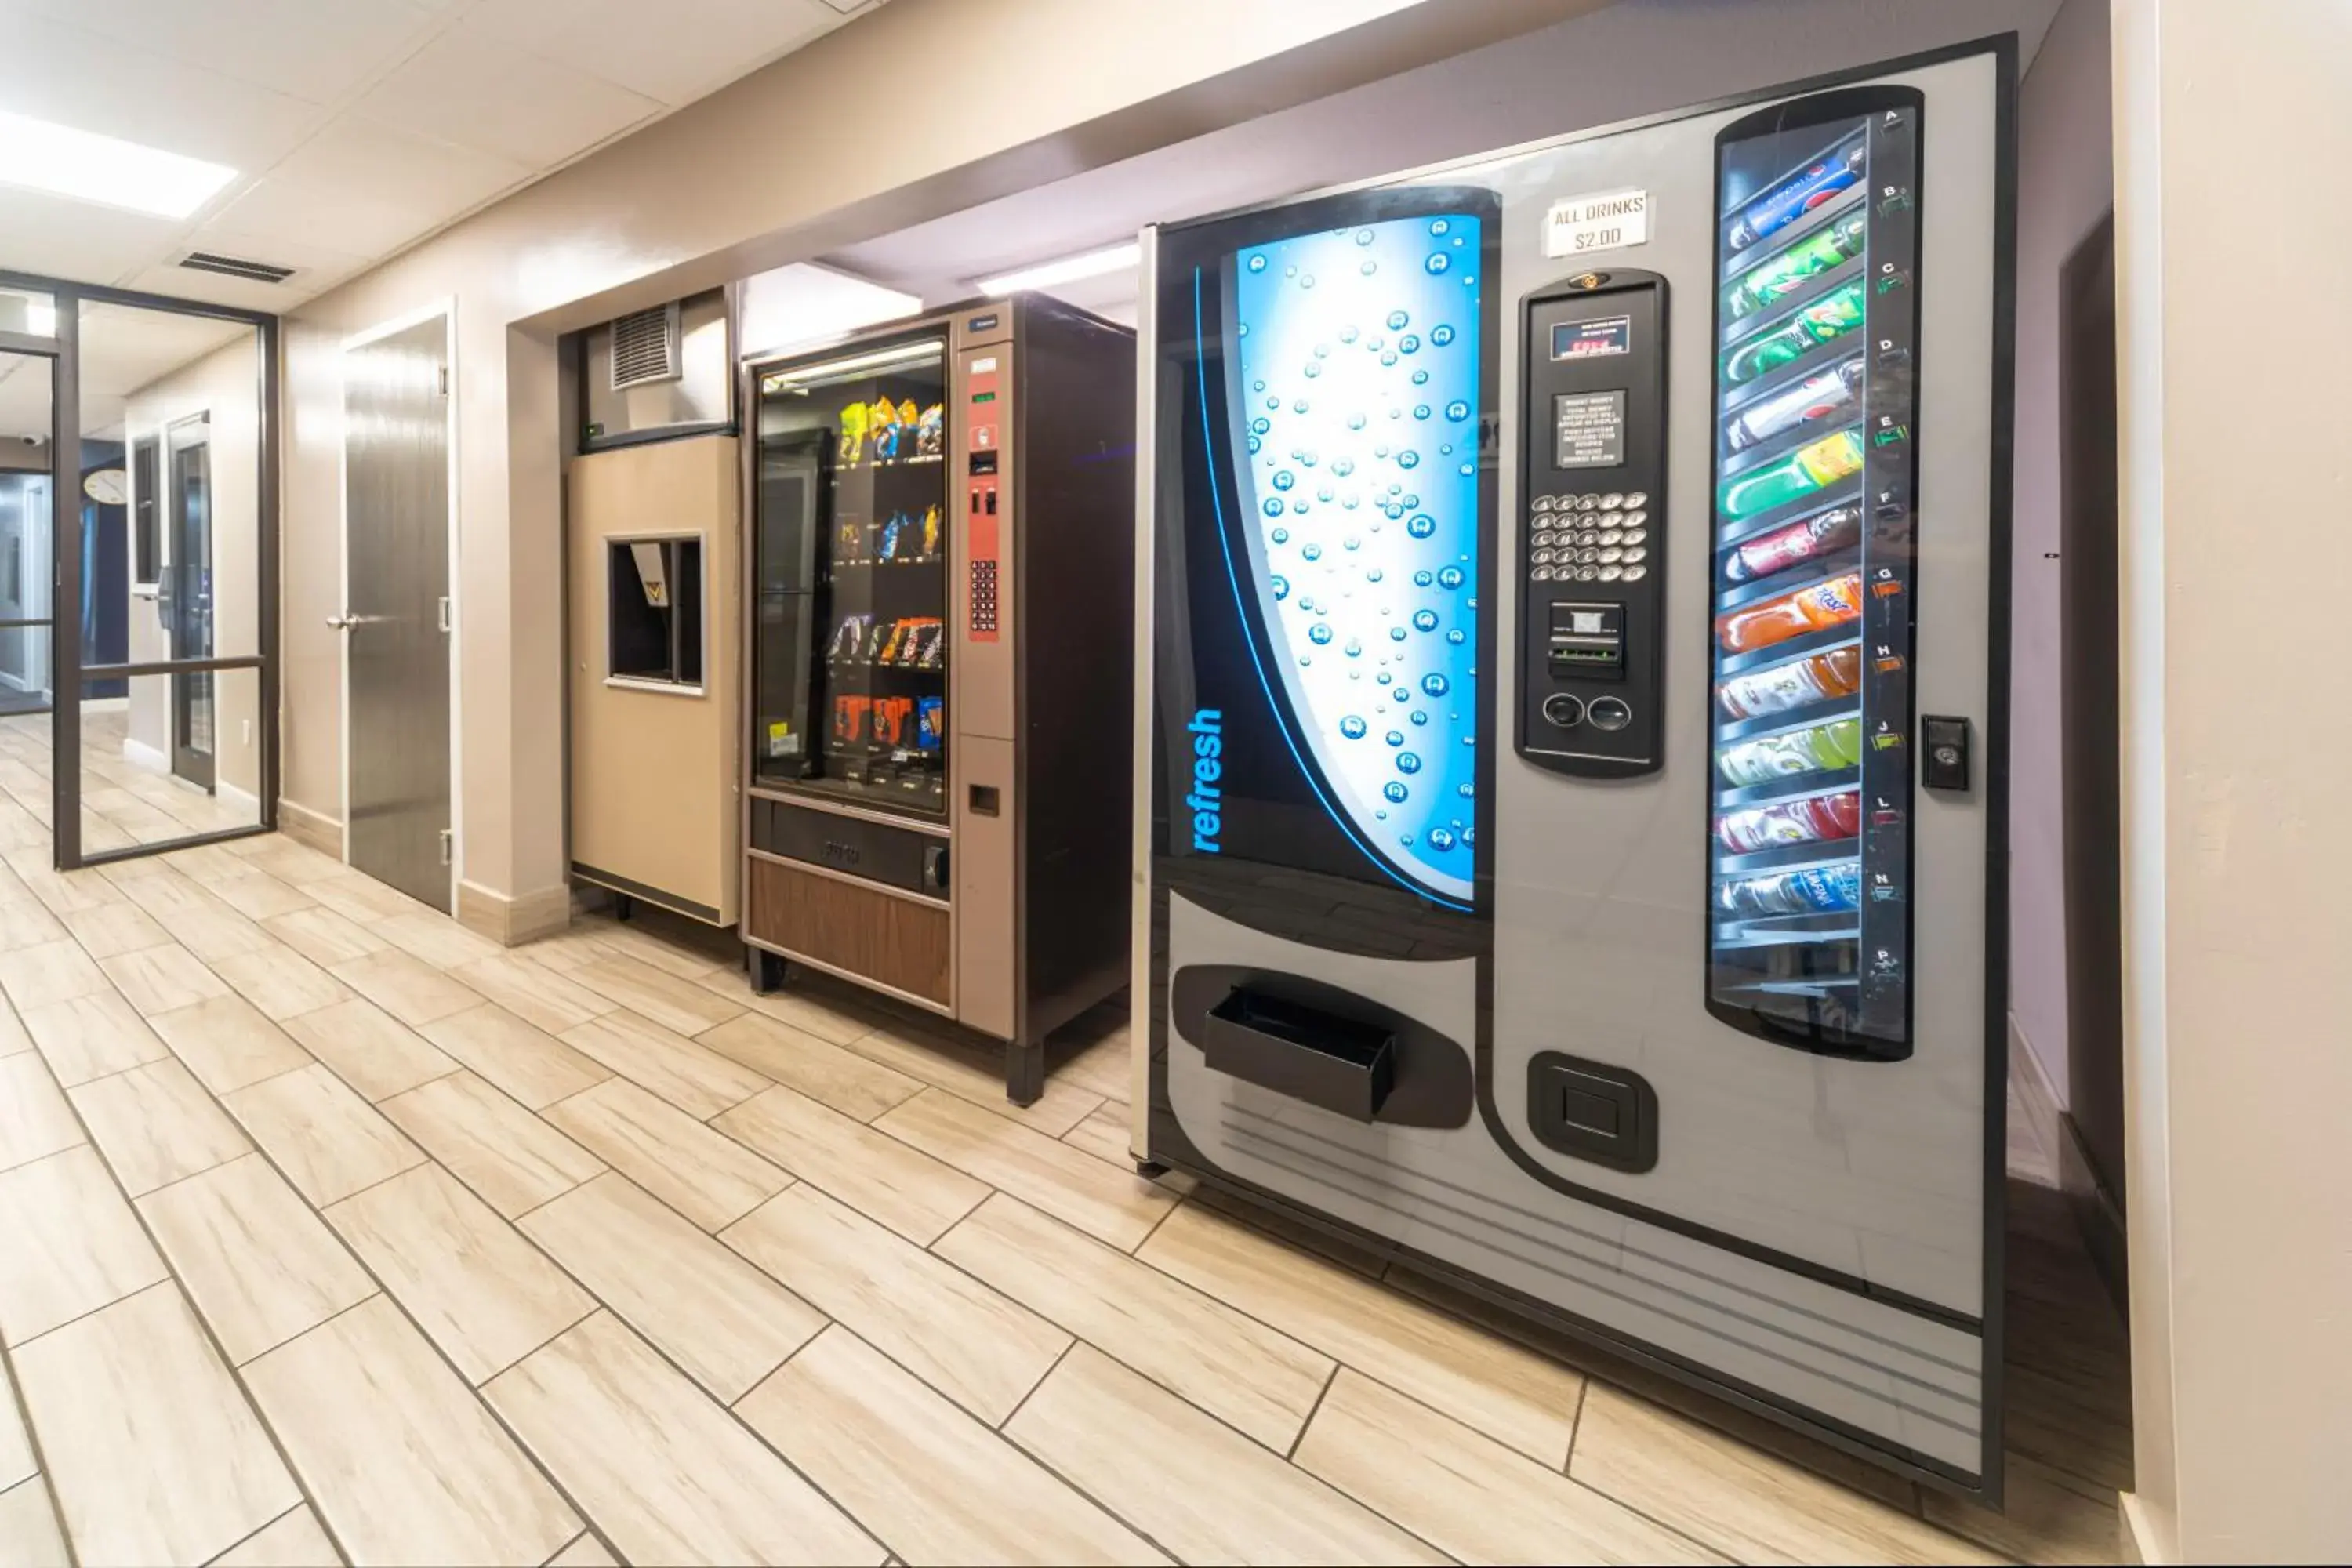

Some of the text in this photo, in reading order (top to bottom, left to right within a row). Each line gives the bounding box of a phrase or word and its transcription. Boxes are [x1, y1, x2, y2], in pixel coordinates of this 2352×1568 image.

[1886, 110, 1897, 122] A
[1884, 185, 1896, 196] B
[1555, 197, 1644, 226] ALL DRINKS
[1575, 227, 1621, 250] $2.00
[1879, 339, 1892, 350] D
[1881, 416, 1893, 426] E
[1877, 644, 1890, 655] H
[1878, 721, 1888, 731] J
[1186, 709, 1221, 852] refresh
[1877, 797, 1890, 807] L
[1875, 873, 1889, 884] N
[1877, 949, 1889, 960] P
